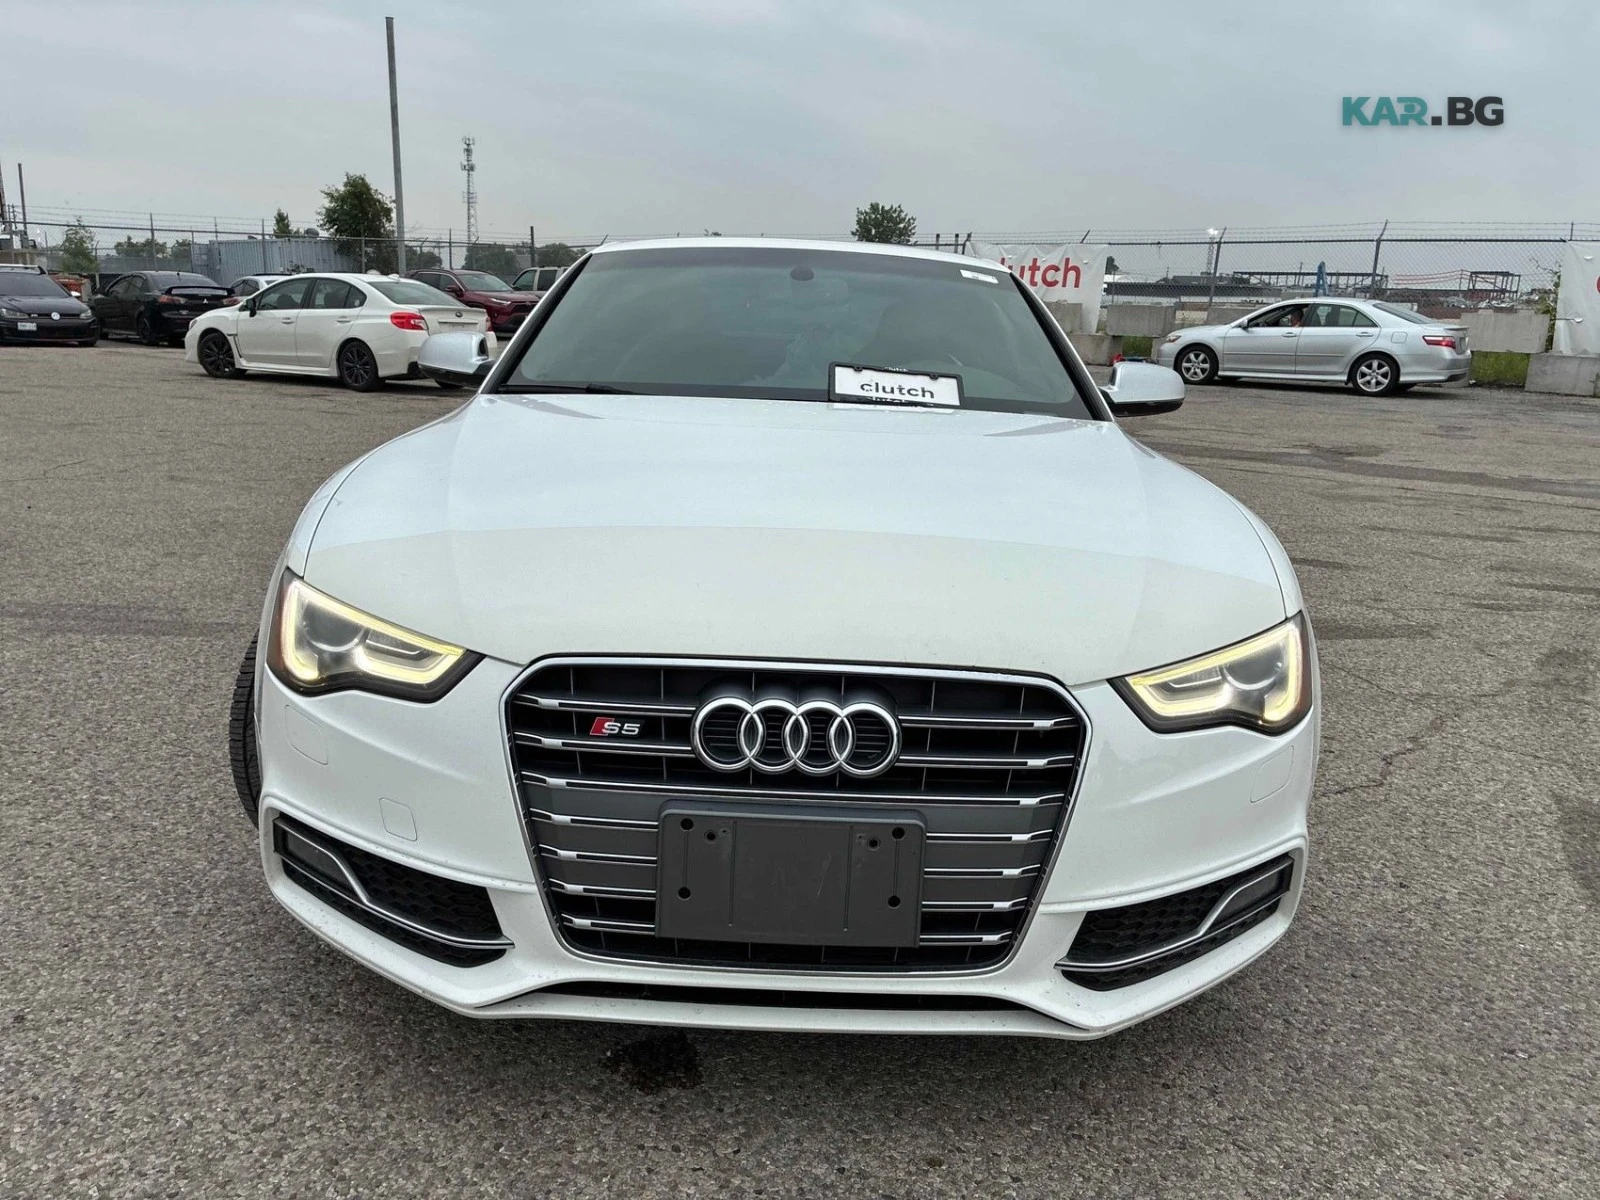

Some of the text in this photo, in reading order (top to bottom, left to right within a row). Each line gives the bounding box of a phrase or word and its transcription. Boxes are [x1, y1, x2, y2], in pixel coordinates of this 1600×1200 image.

[1000, 257, 1082, 288] tch
[860, 382, 935, 399] clutch
[602, 721, 640, 735] S5
